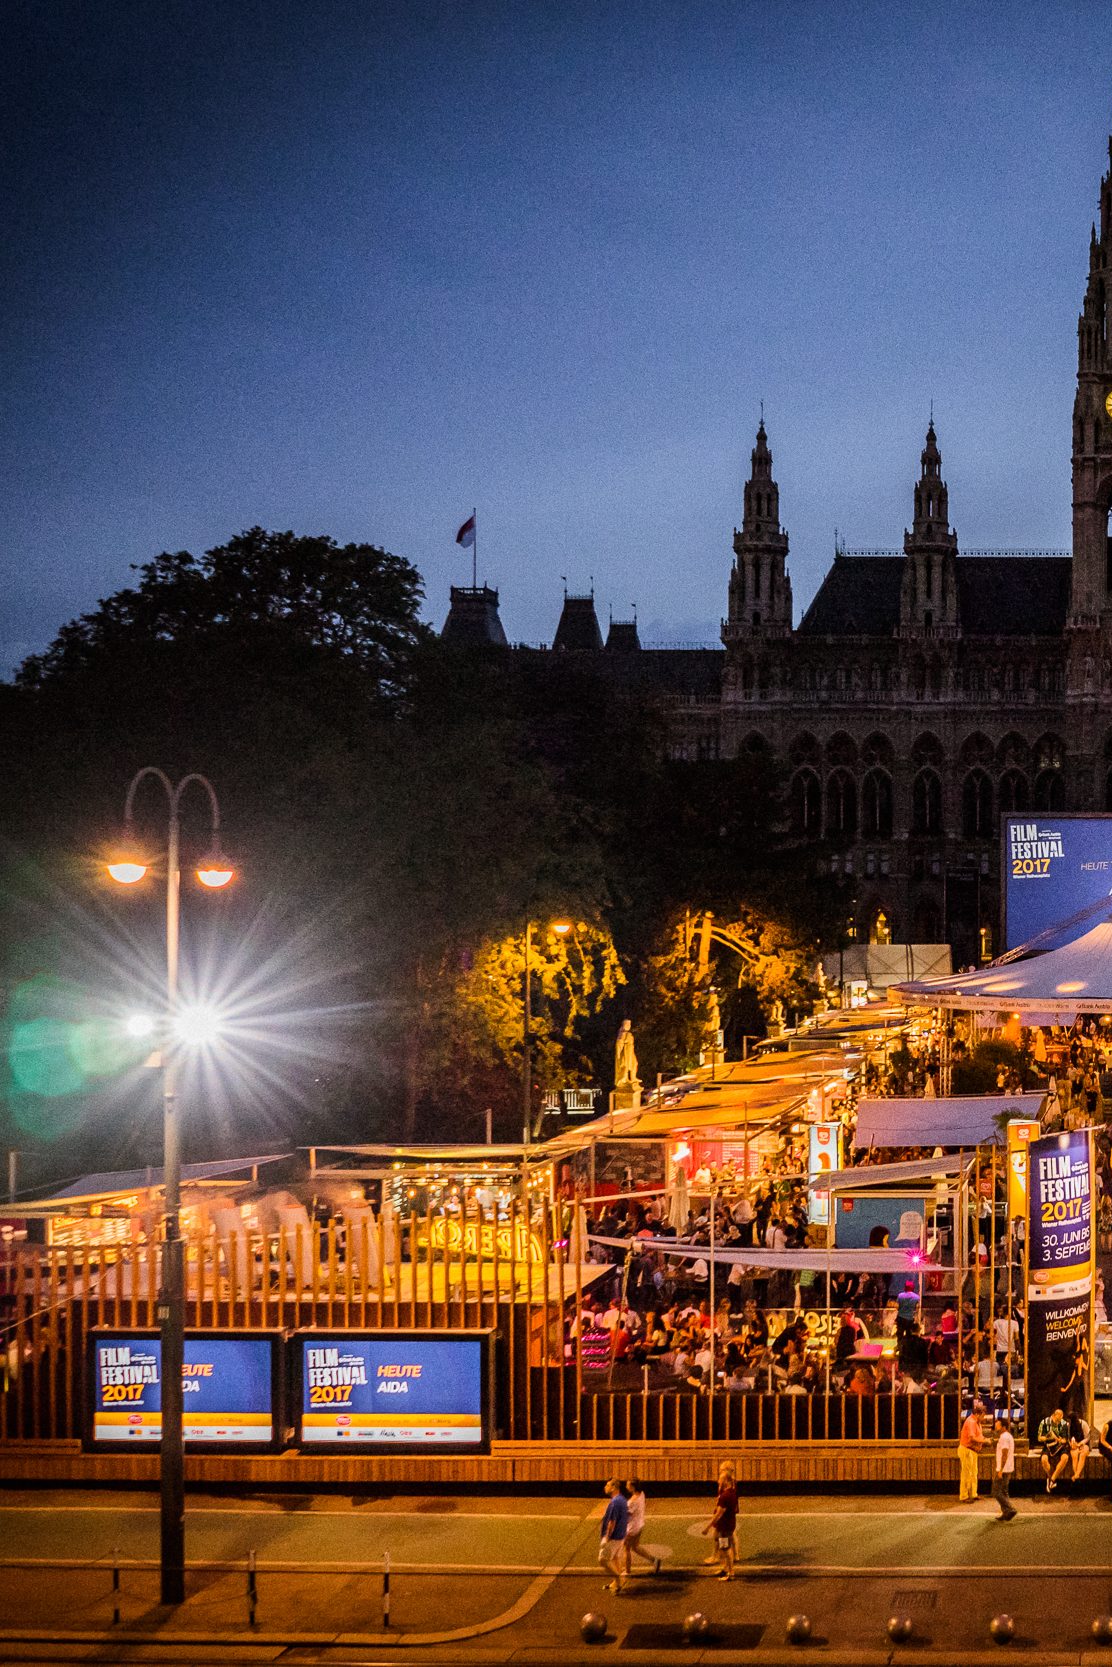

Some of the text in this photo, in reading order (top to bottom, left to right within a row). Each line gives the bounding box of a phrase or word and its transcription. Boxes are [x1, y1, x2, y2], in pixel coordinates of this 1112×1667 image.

[1010, 824, 1038, 842] FILM
[1011, 841, 1065, 860] FESTIVAL
[1012, 859, 1051, 874] 2017
[1080, 862, 1109, 870] HEUTE
[1039, 1156, 1071, 1180] FILM
[1040, 1173, 1090, 1202] FESTIVAL
[1041, 1198, 1082, 1222] 2017
[1042, 1234, 1058, 1248] 30.
[1060, 1230, 1081, 1245] JUNI
[1042, 1250, 1052, 1262] 3.
[100, 1347, 130, 1366] FILM
[307, 1348, 338, 1368] FILM
[100, 1364, 160, 1385] FESTIVAL
[181, 1364, 214, 1377] EUTE
[308, 1366, 368, 1387] FESTIVAL
[376, 1364, 423, 1378] HEUTE
[102, 1384, 144, 1402] 2017
[182, 1380, 200, 1392] DA
[310, 1386, 352, 1403] 2017
[376, 1382, 408, 1394] AIDA
